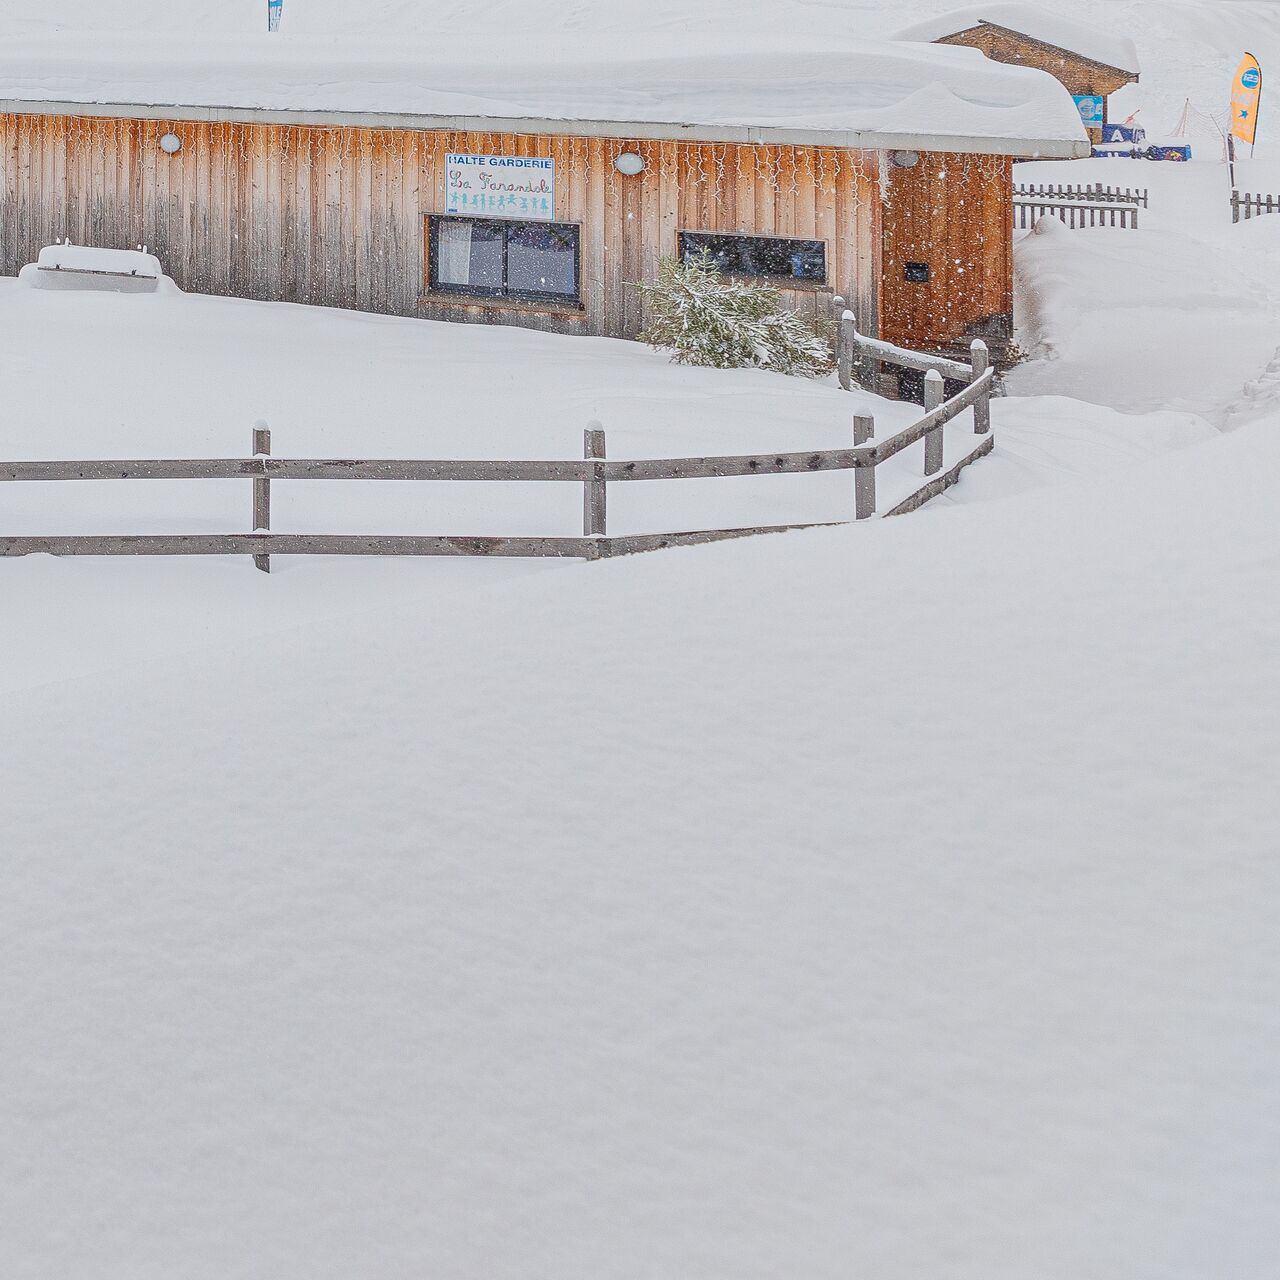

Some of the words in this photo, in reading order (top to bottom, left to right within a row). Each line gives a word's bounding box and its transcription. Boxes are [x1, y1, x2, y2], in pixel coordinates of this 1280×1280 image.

[448, 156, 486, 166] HALTE
[489, 158, 552, 169] GARDERIE
[449, 169, 472, 189] La
[479, 171, 552, 193] Farandole
